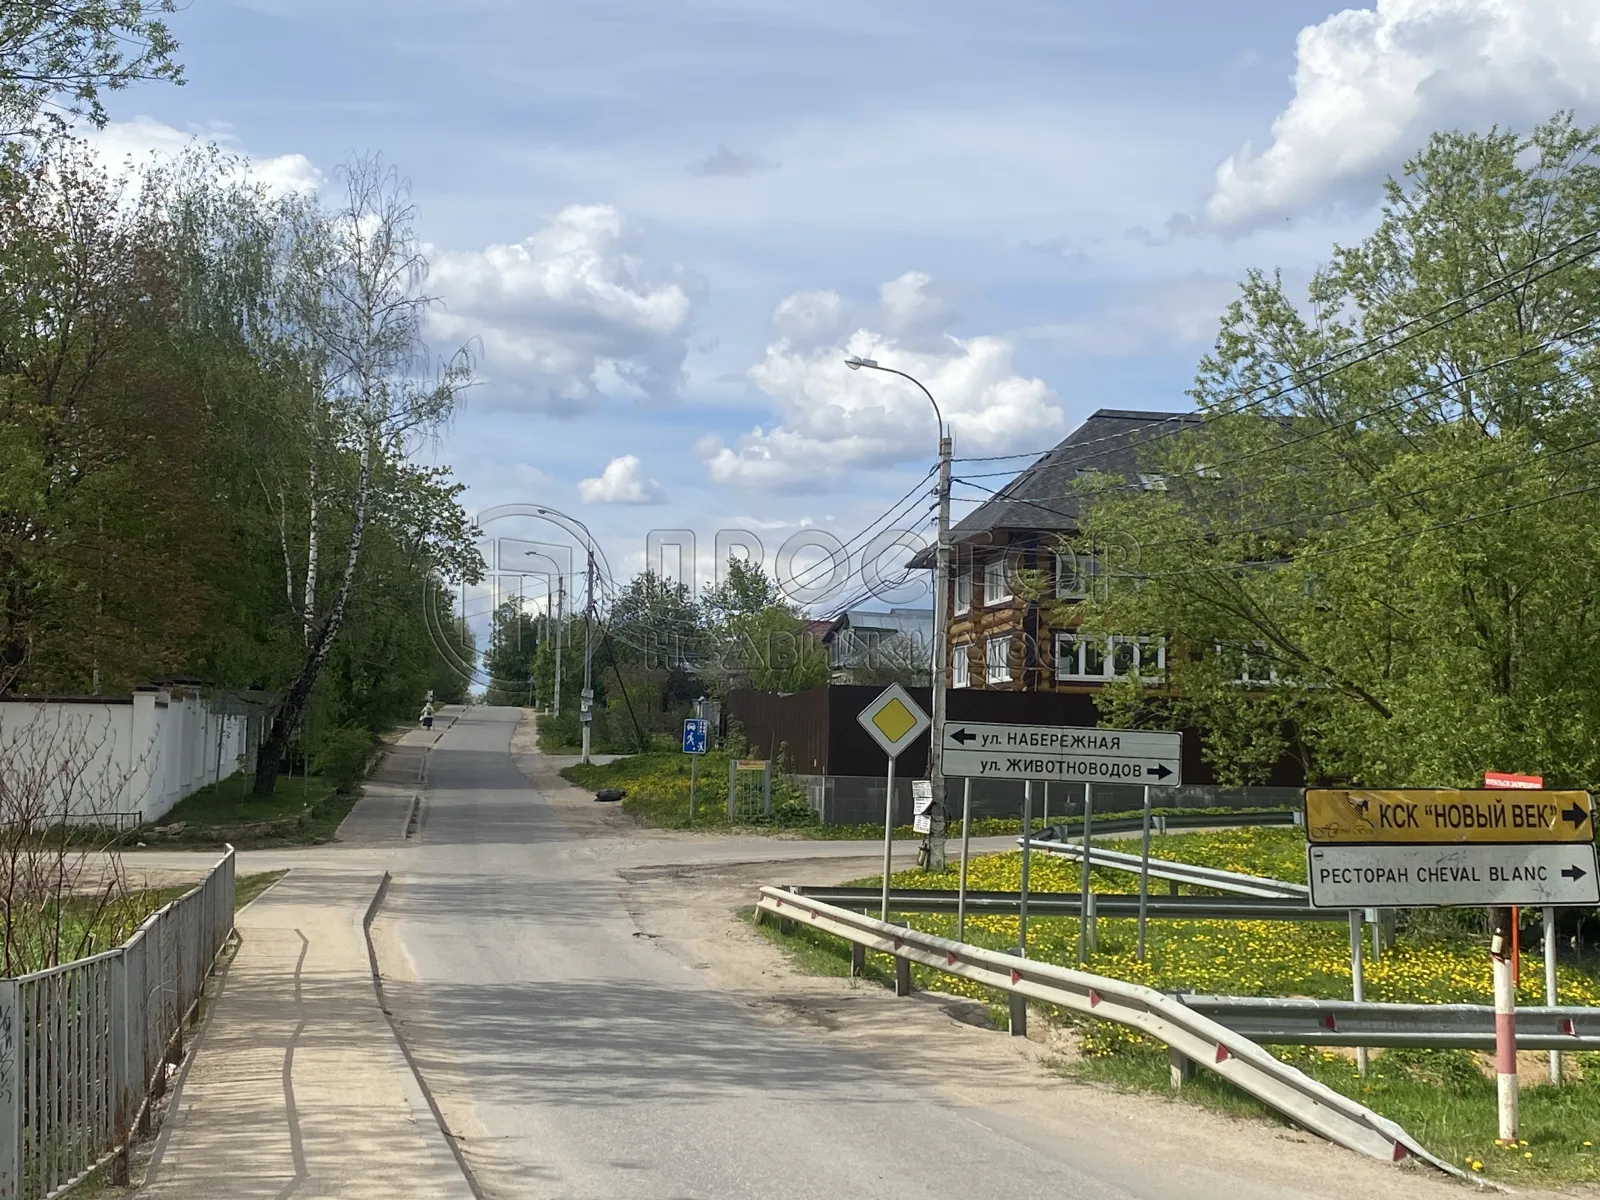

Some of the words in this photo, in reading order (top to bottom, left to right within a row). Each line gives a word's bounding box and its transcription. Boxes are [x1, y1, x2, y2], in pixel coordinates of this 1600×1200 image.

[982, 734, 1002, 747] ул.
[1007, 732, 1120, 750] НАБЕРЕЖНАЯ
[980, 760, 1001, 773] ул.
[1006, 758, 1142, 778] ЖИВОТНОВОДОВ
[1379, 804, 1419, 829] КСК
[1320, 868, 1410, 884] РЕСТОРАН
[1416, 866, 1480, 882] CHEVAL
[1489, 865, 1548, 881] BLANC
